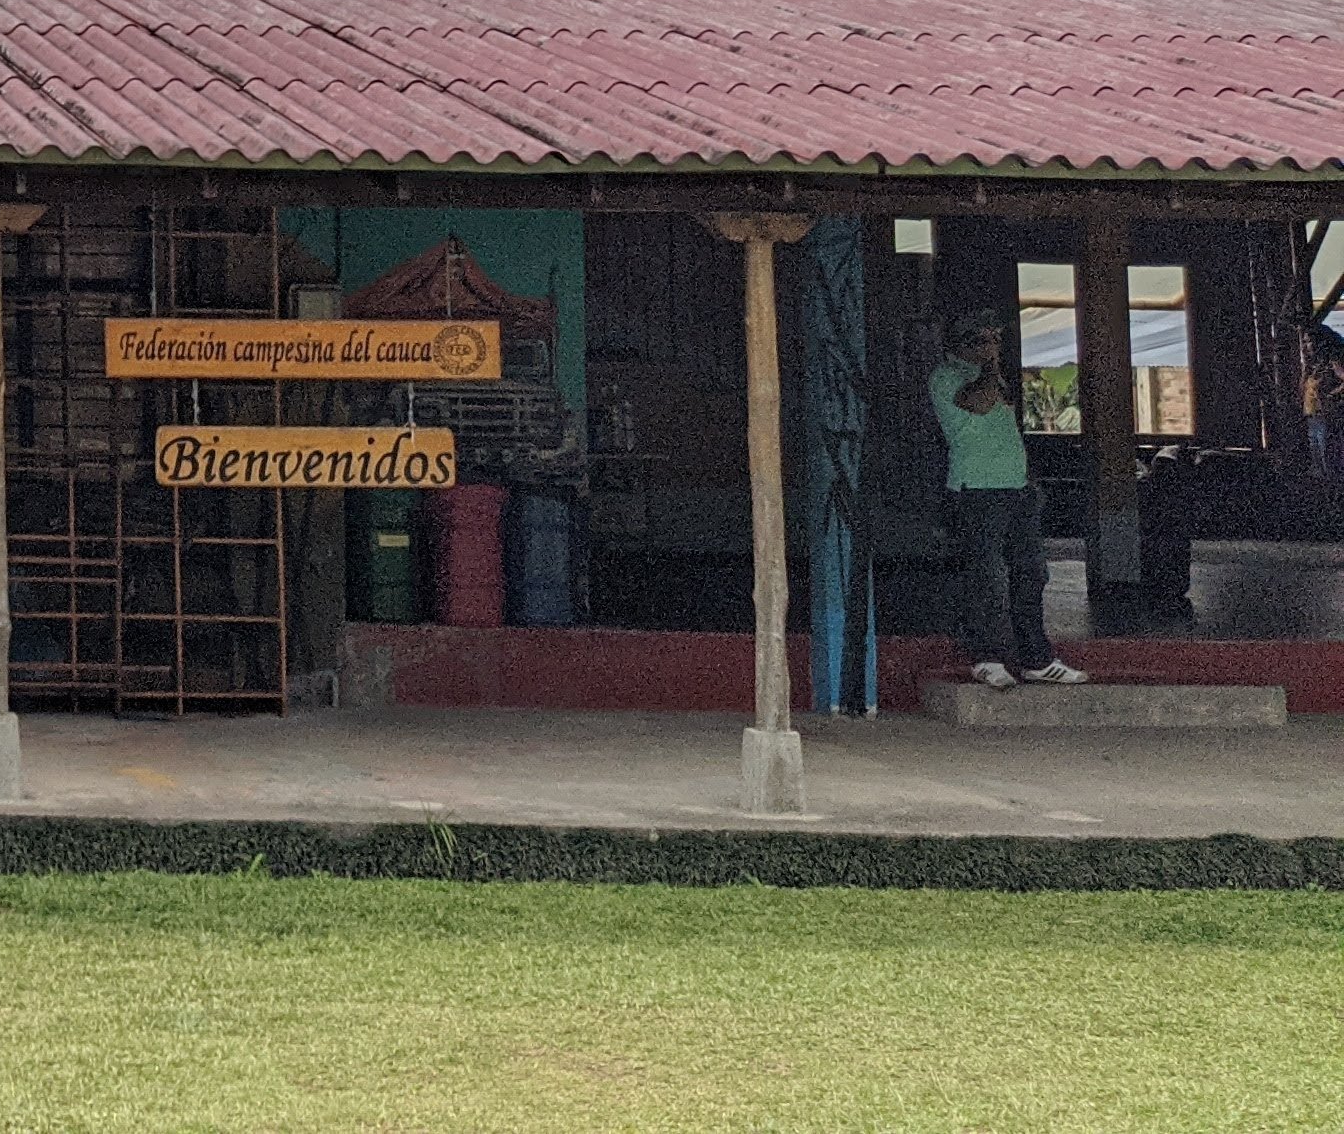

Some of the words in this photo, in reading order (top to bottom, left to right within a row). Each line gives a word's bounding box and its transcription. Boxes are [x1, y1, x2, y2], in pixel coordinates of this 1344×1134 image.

[119, 327, 227, 361] Federación
[233, 332, 334, 372] campesina
[341, 329, 374, 362] del
[376, 340, 432, 362] cauca
[159, 431, 453, 485] Bienvenidos
